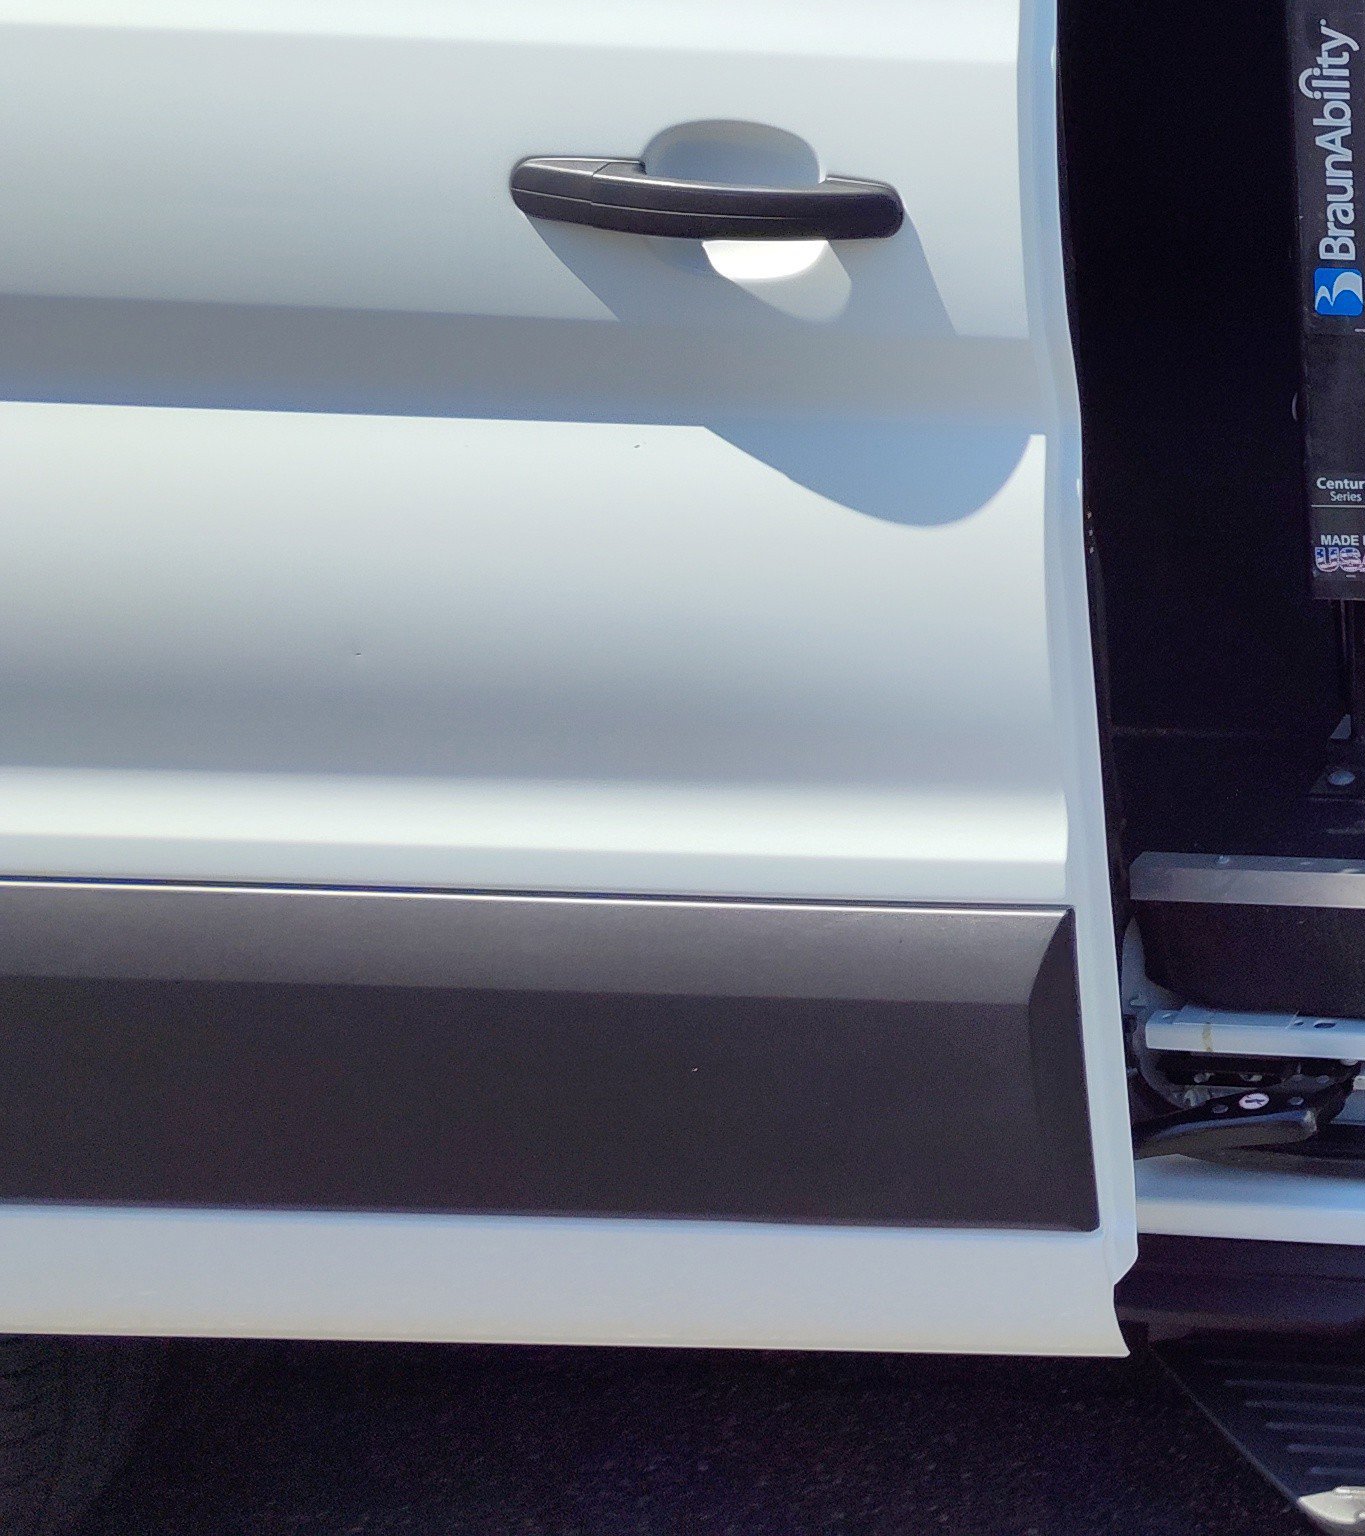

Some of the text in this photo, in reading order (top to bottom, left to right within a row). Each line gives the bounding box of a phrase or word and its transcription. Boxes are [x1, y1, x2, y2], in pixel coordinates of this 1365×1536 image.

[1298, 20, 1360, 262] BraunAbility
[1330, 490, 1363, 502] Series
[1320, 534, 1360, 546] MADE
